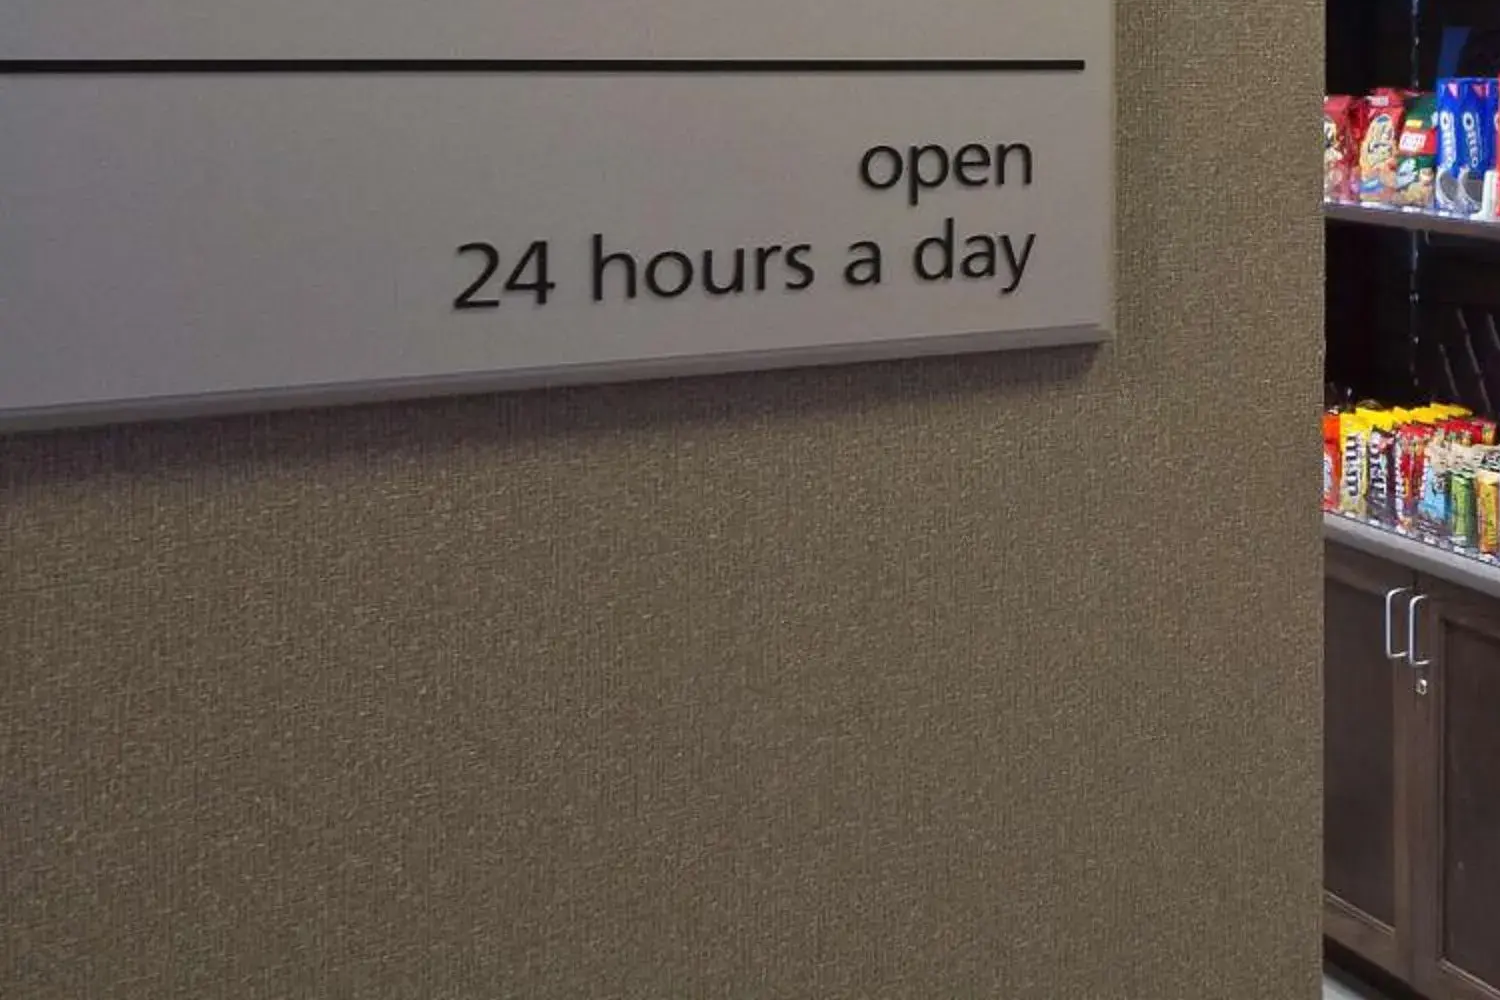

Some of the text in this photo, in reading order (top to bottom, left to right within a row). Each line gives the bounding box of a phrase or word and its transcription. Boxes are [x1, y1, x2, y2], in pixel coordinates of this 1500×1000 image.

[858, 142, 1034, 208] open
[452, 216, 1038, 312] 24 hours a day
